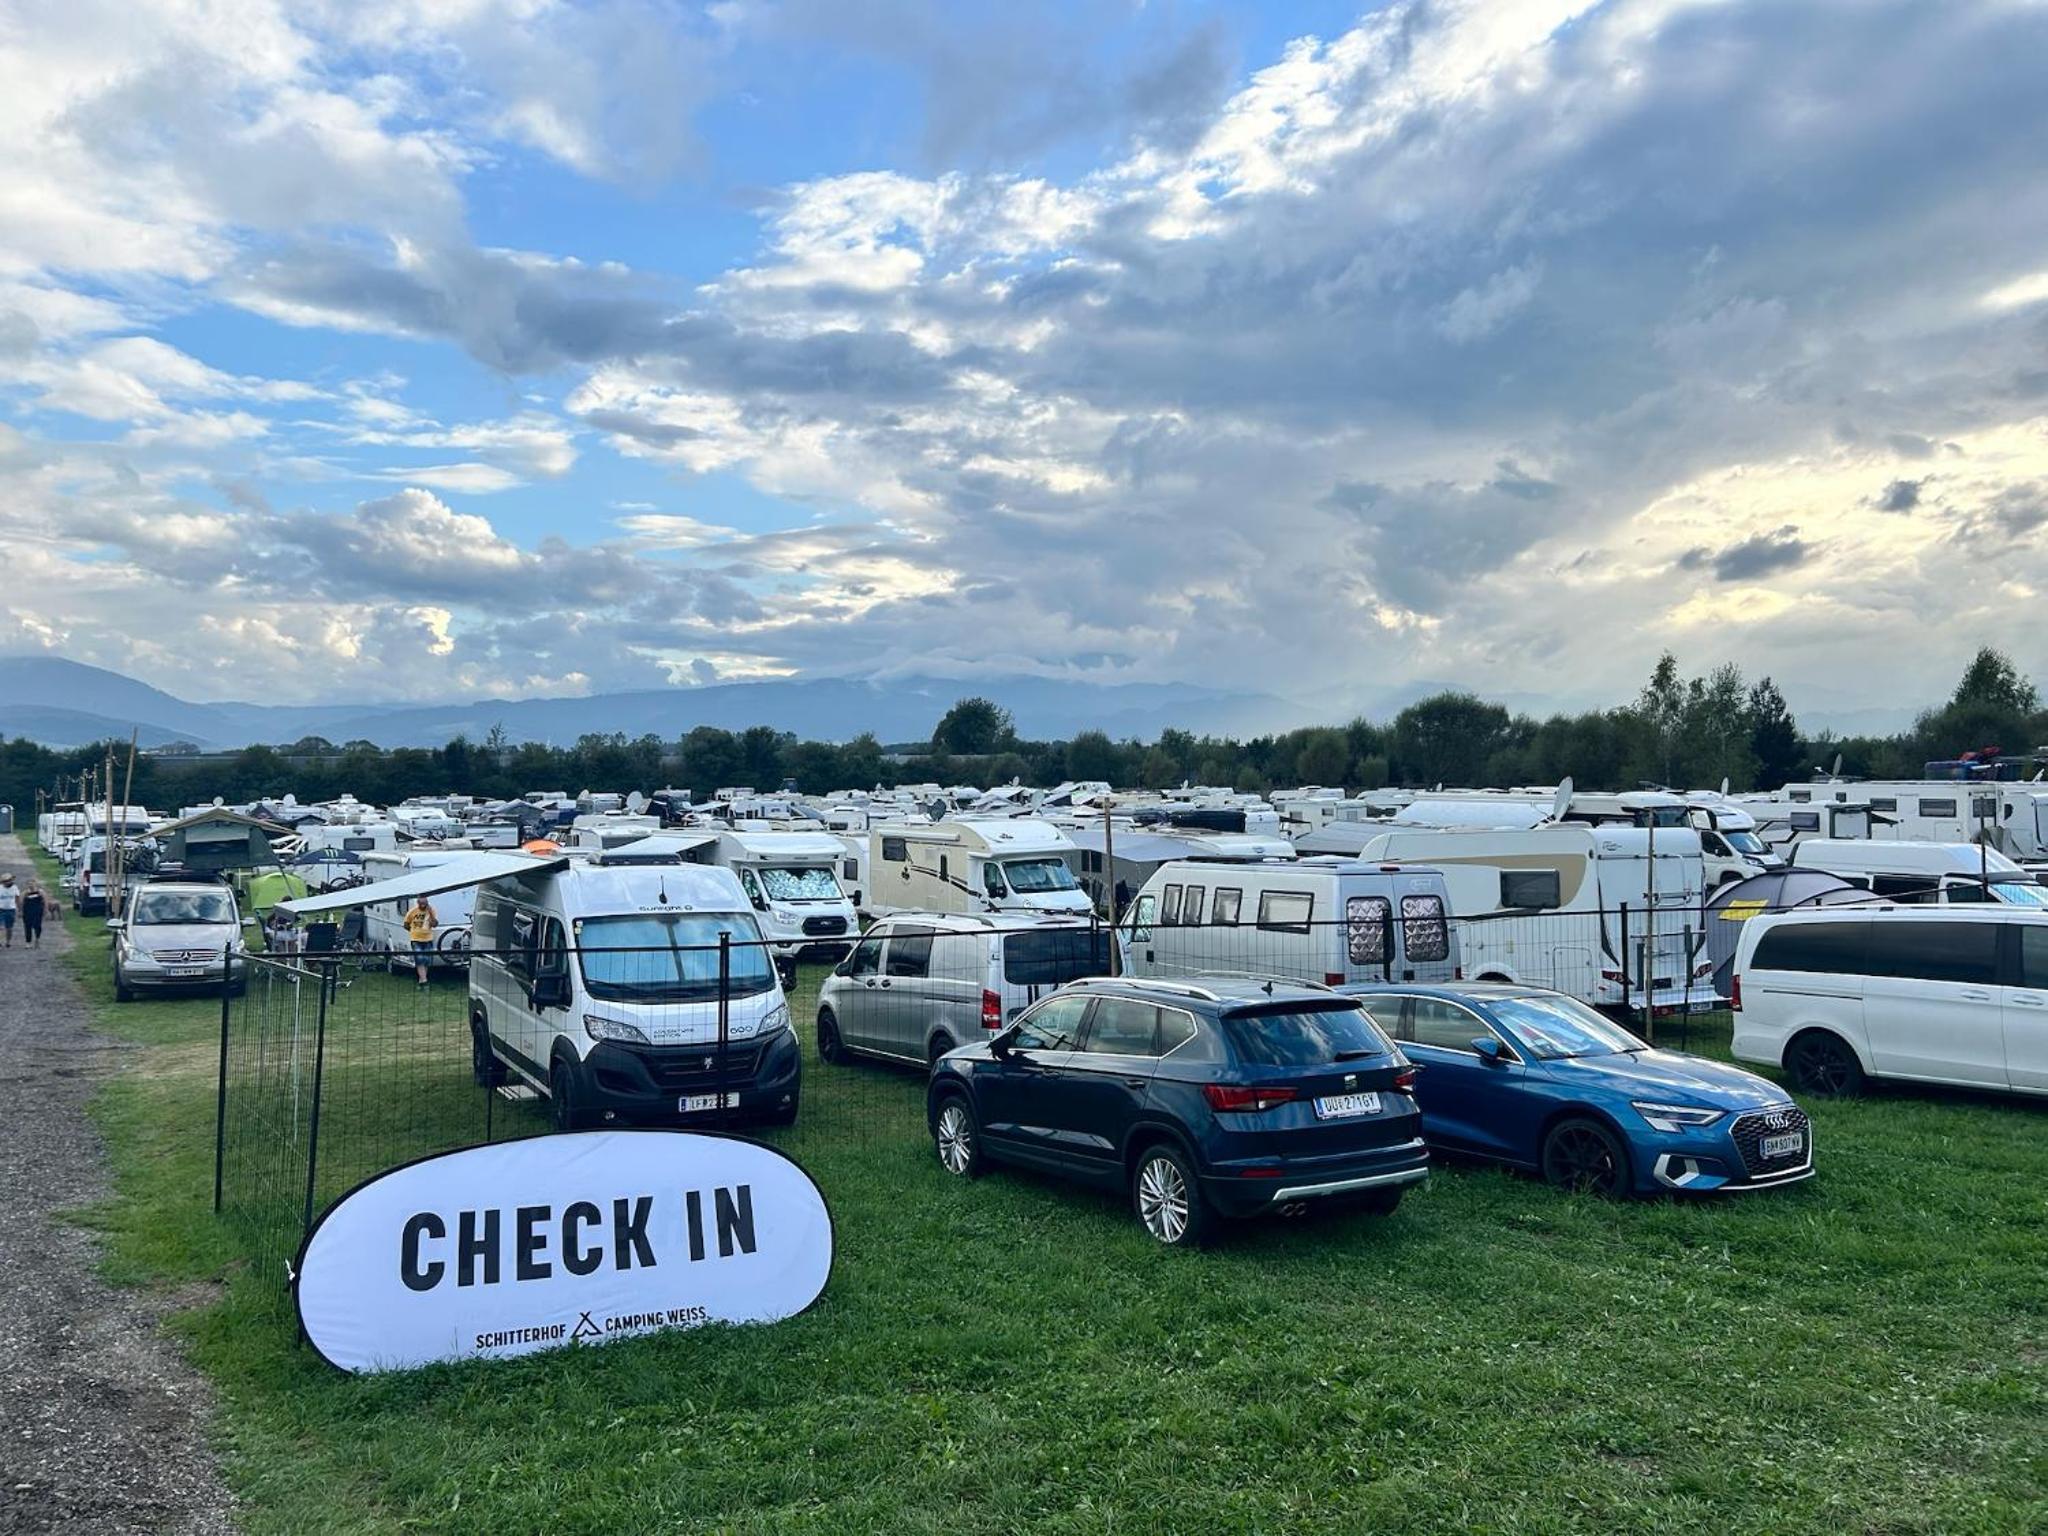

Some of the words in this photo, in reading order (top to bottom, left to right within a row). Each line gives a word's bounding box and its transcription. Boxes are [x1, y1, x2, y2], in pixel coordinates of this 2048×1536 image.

[1344, 1094, 1376, 1110] 271GY
[401, 1196, 657, 1292] CHECK
[686, 1185, 757, 1262] IN
[476, 1324, 567, 1349] SCHITTERHOF
[605, 1311, 663, 1332] CAMPING
[667, 1306, 706, 1325] WEISS
